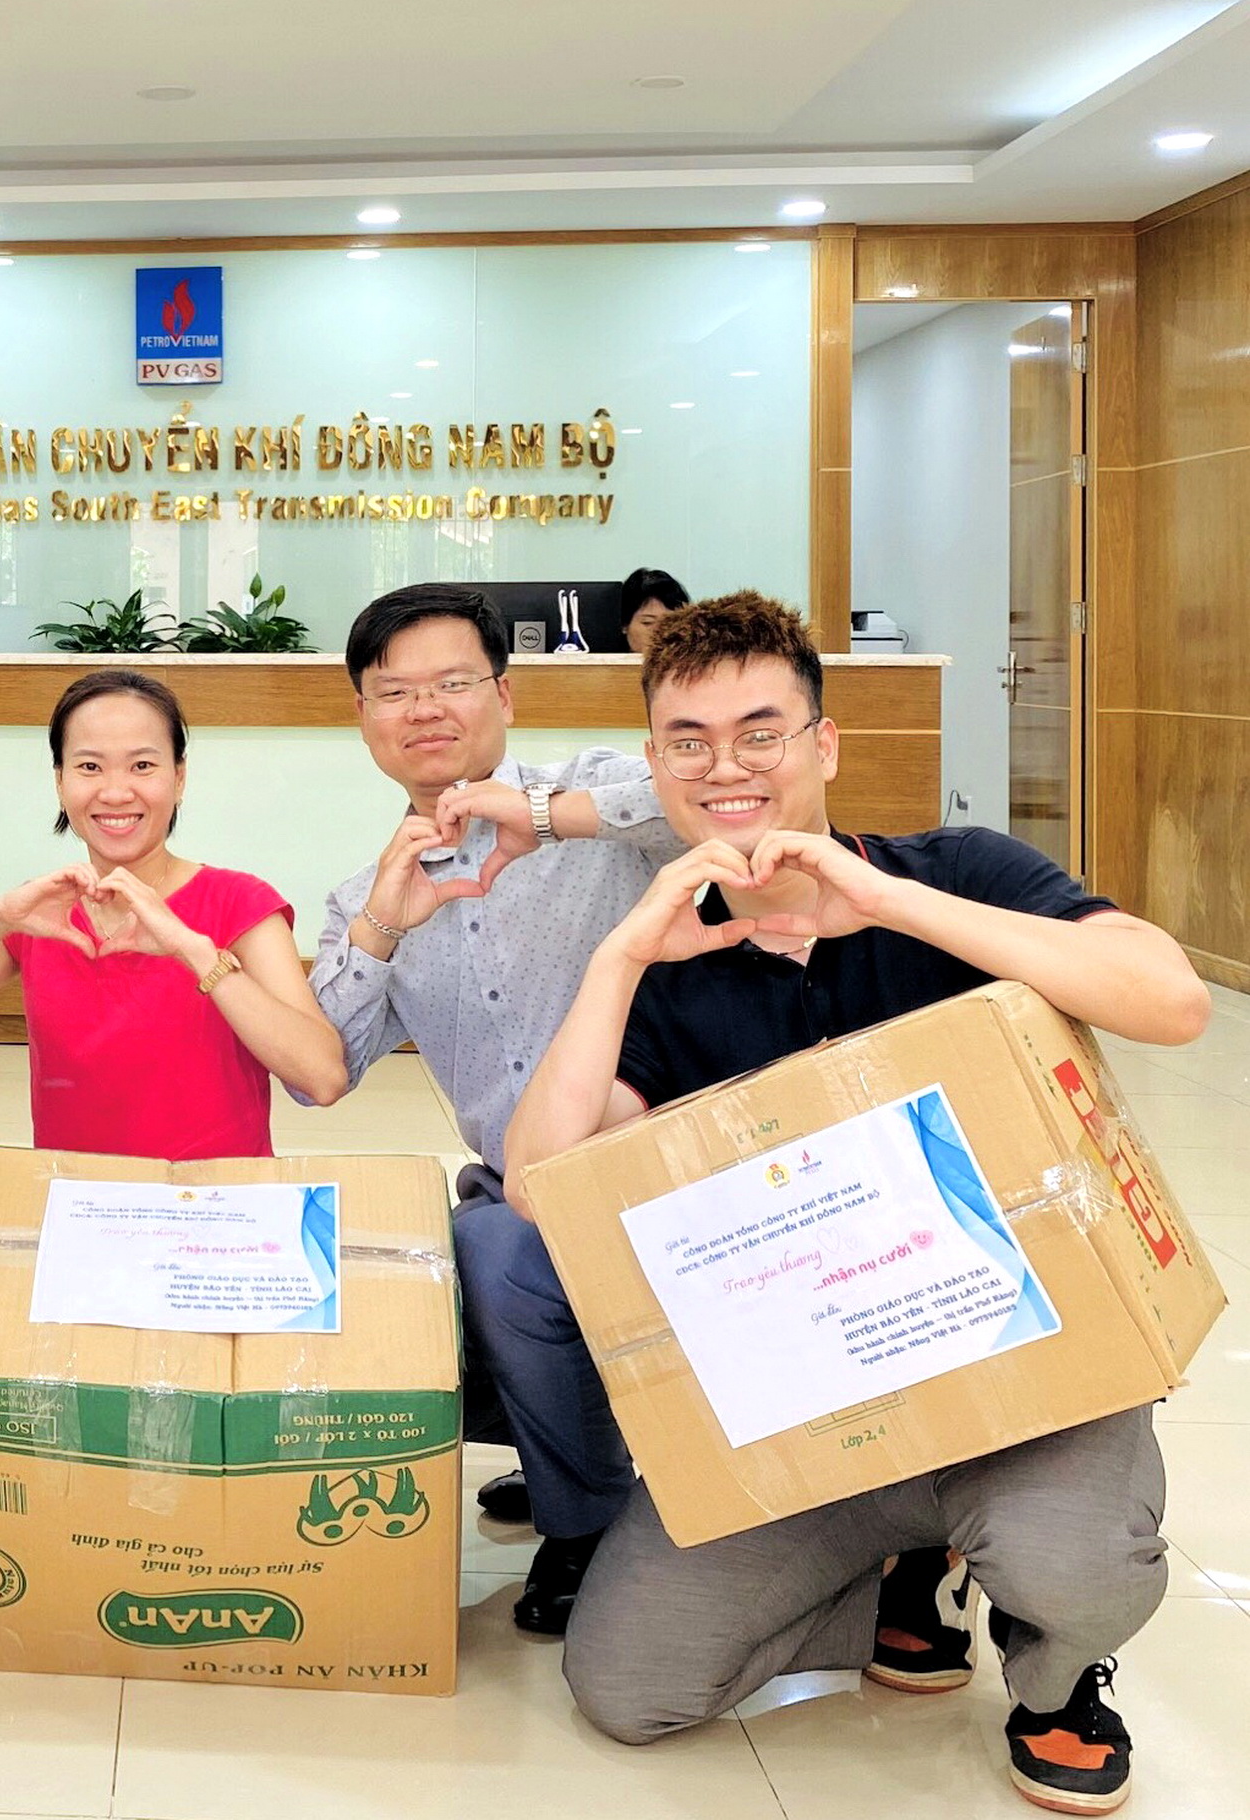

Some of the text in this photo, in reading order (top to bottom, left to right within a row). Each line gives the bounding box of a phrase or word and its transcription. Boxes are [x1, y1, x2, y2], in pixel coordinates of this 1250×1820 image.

[140, 334, 219, 348] PETROVIETNAM
[142, 363, 217, 378] PV GAS
[51, 399, 219, 474] CHUYỂN
[234, 414, 305, 471] KHÍ
[317, 411, 433, 471] ĐÔNG
[449, 423, 545, 470] NAM
[561, 408, 616, 479] BỘ
[52, 490, 140, 522] South
[152, 491, 219, 522] East
[238, 489, 450, 521] Transmission
[466, 486, 614, 525] Company
[786, 1207, 798, 1217] TY
[839, 1182, 862, 1196] NAM
[843, 1195, 865, 1209] NAM
[860, 1259, 877, 1273] nụ
[879, 1242, 913, 1266] cười
[389, 1413, 414, 1423] 120
[6, 1420, 36, 1435] ISO
[402, 1426, 426, 1438] 100
[349, 1431, 356, 1441] 2
[71, 1533, 110, 1549] đình
[116, 1538, 142, 1552] gia
[172, 1546, 203, 1558] cho
[126, 1605, 275, 1634] AnAn
[183, 1661, 284, 1676] POP-UP
